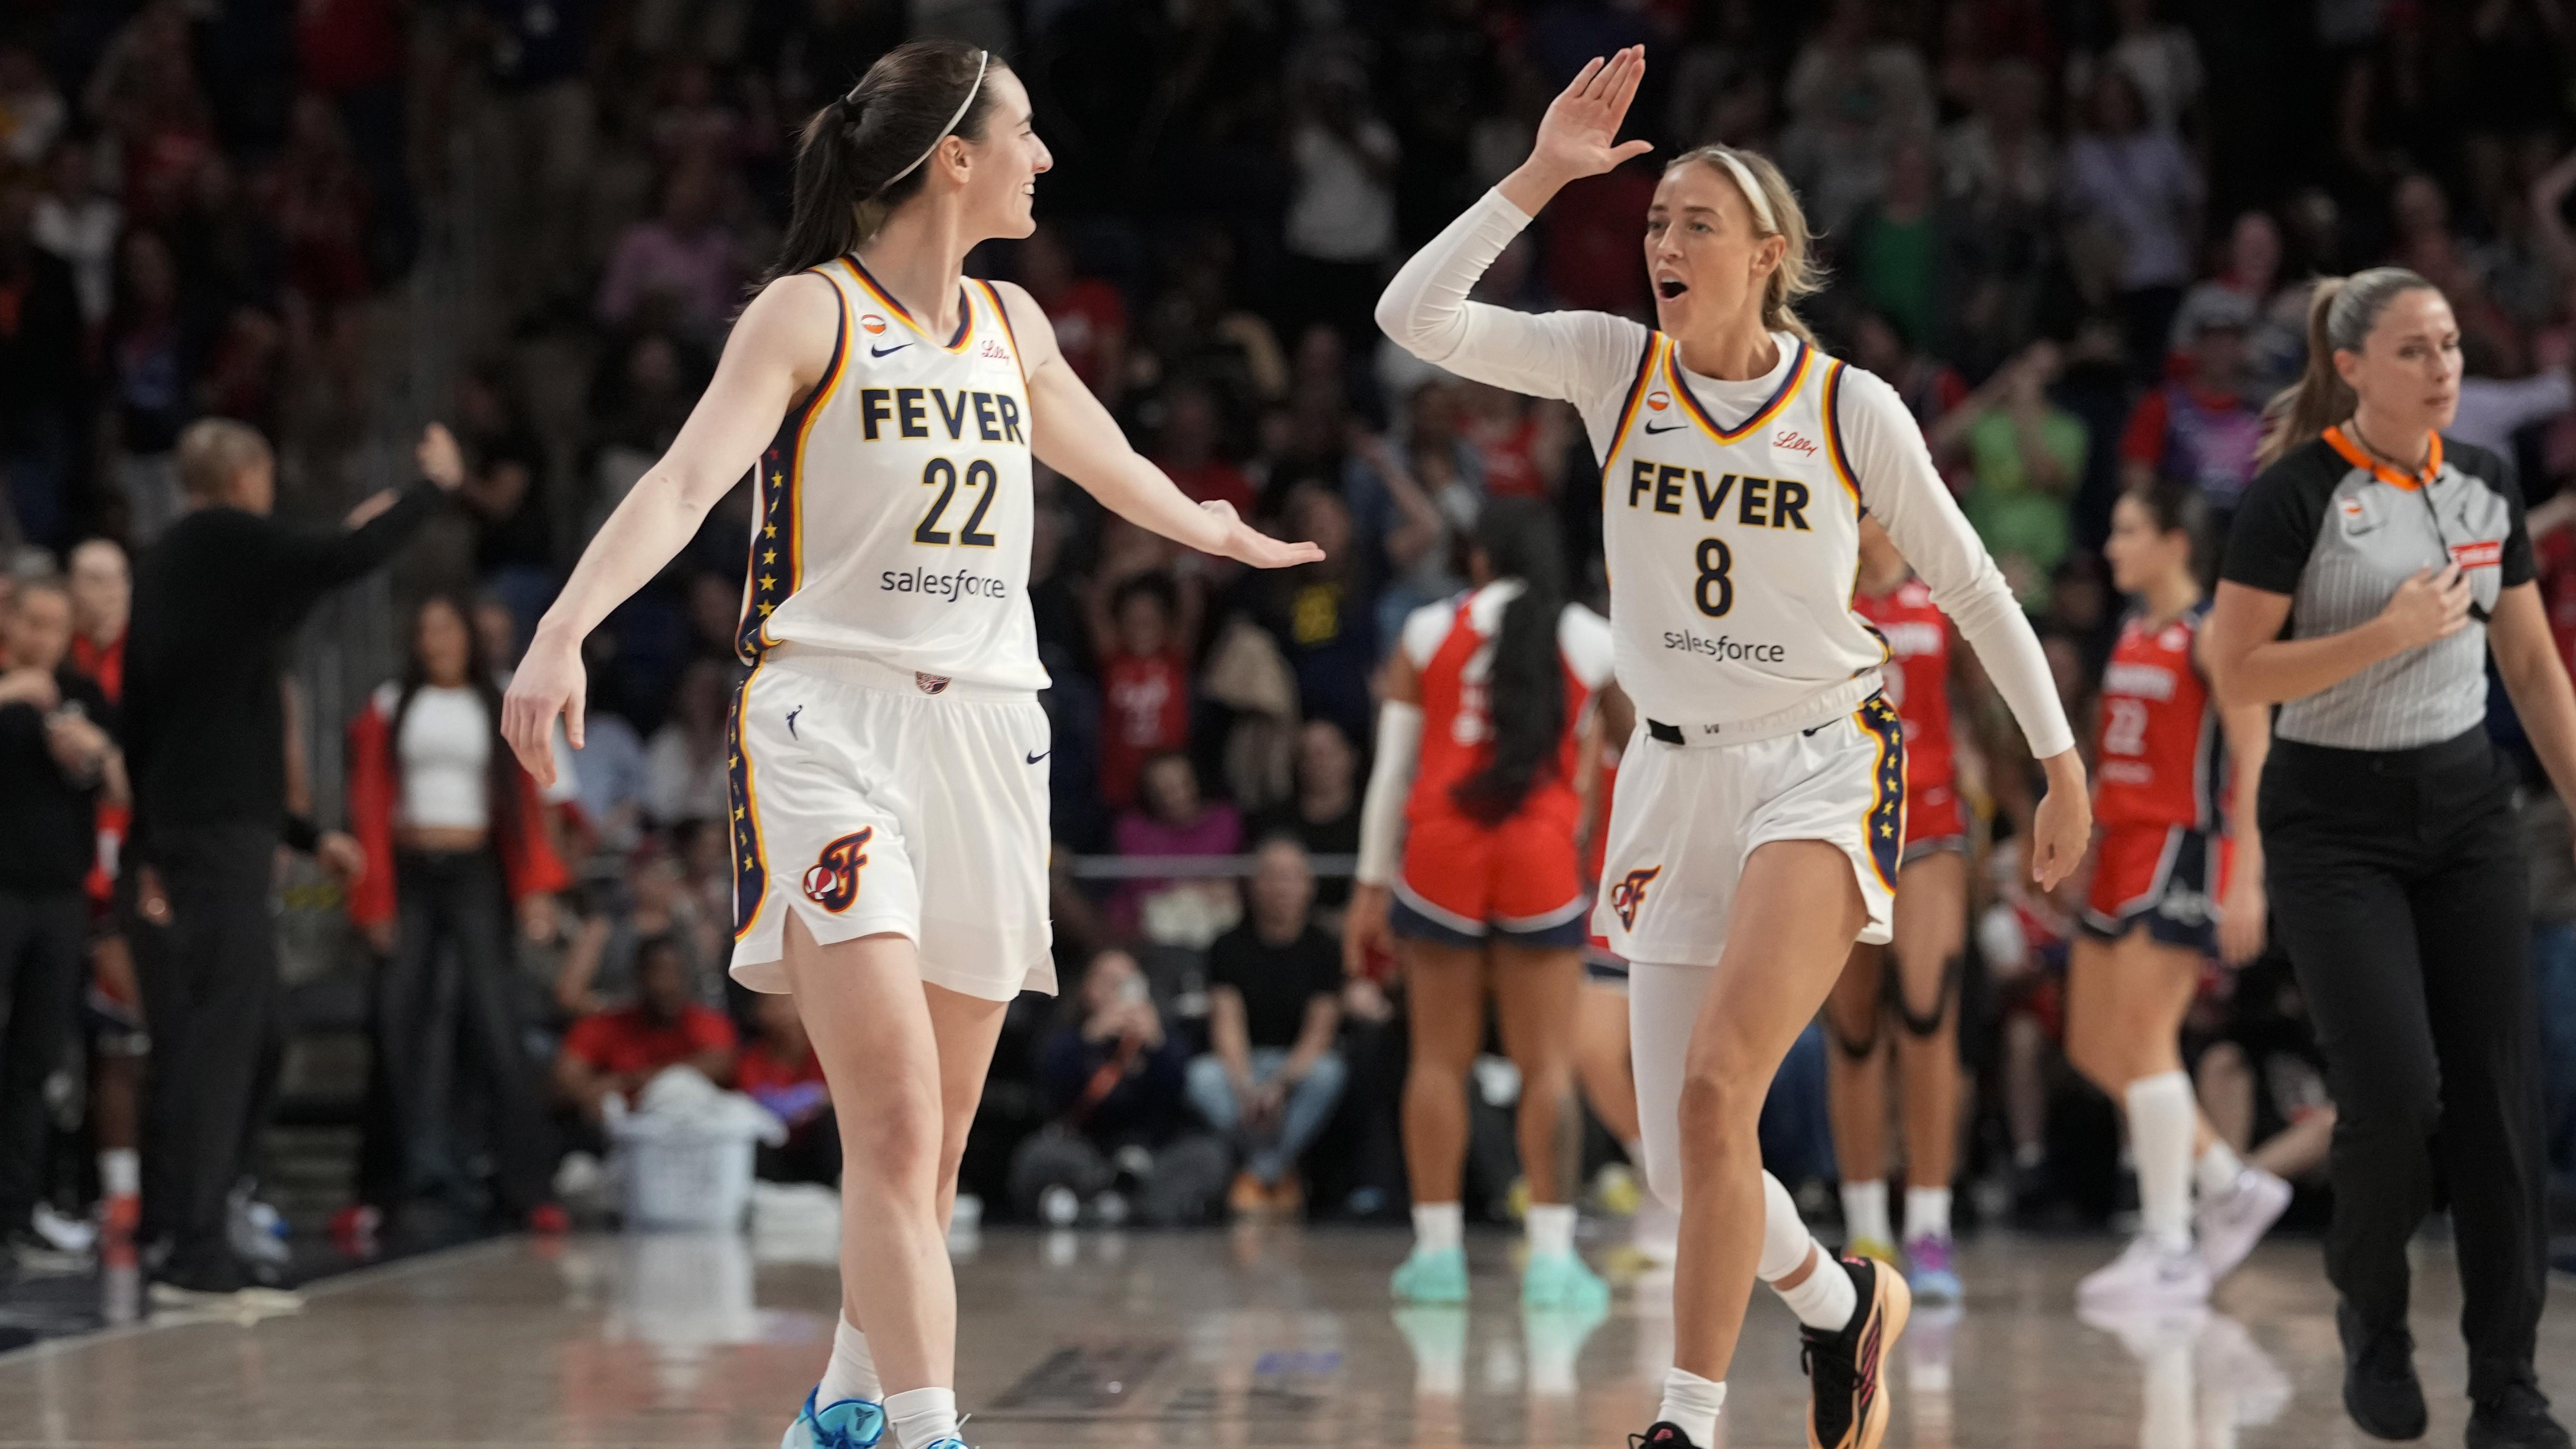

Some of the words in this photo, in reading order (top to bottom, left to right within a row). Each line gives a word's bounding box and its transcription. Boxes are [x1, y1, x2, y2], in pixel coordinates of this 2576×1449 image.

[859, 387, 1026, 445] FEVER
[1773, 431, 1818, 457] Lilly
[913, 456, 998, 549] 22
[1628, 459, 1814, 531] FEVER
[881, 567, 1007, 602] salesforce
[1694, 537, 1733, 618] 8
[1664, 630, 1785, 662] salesforce
